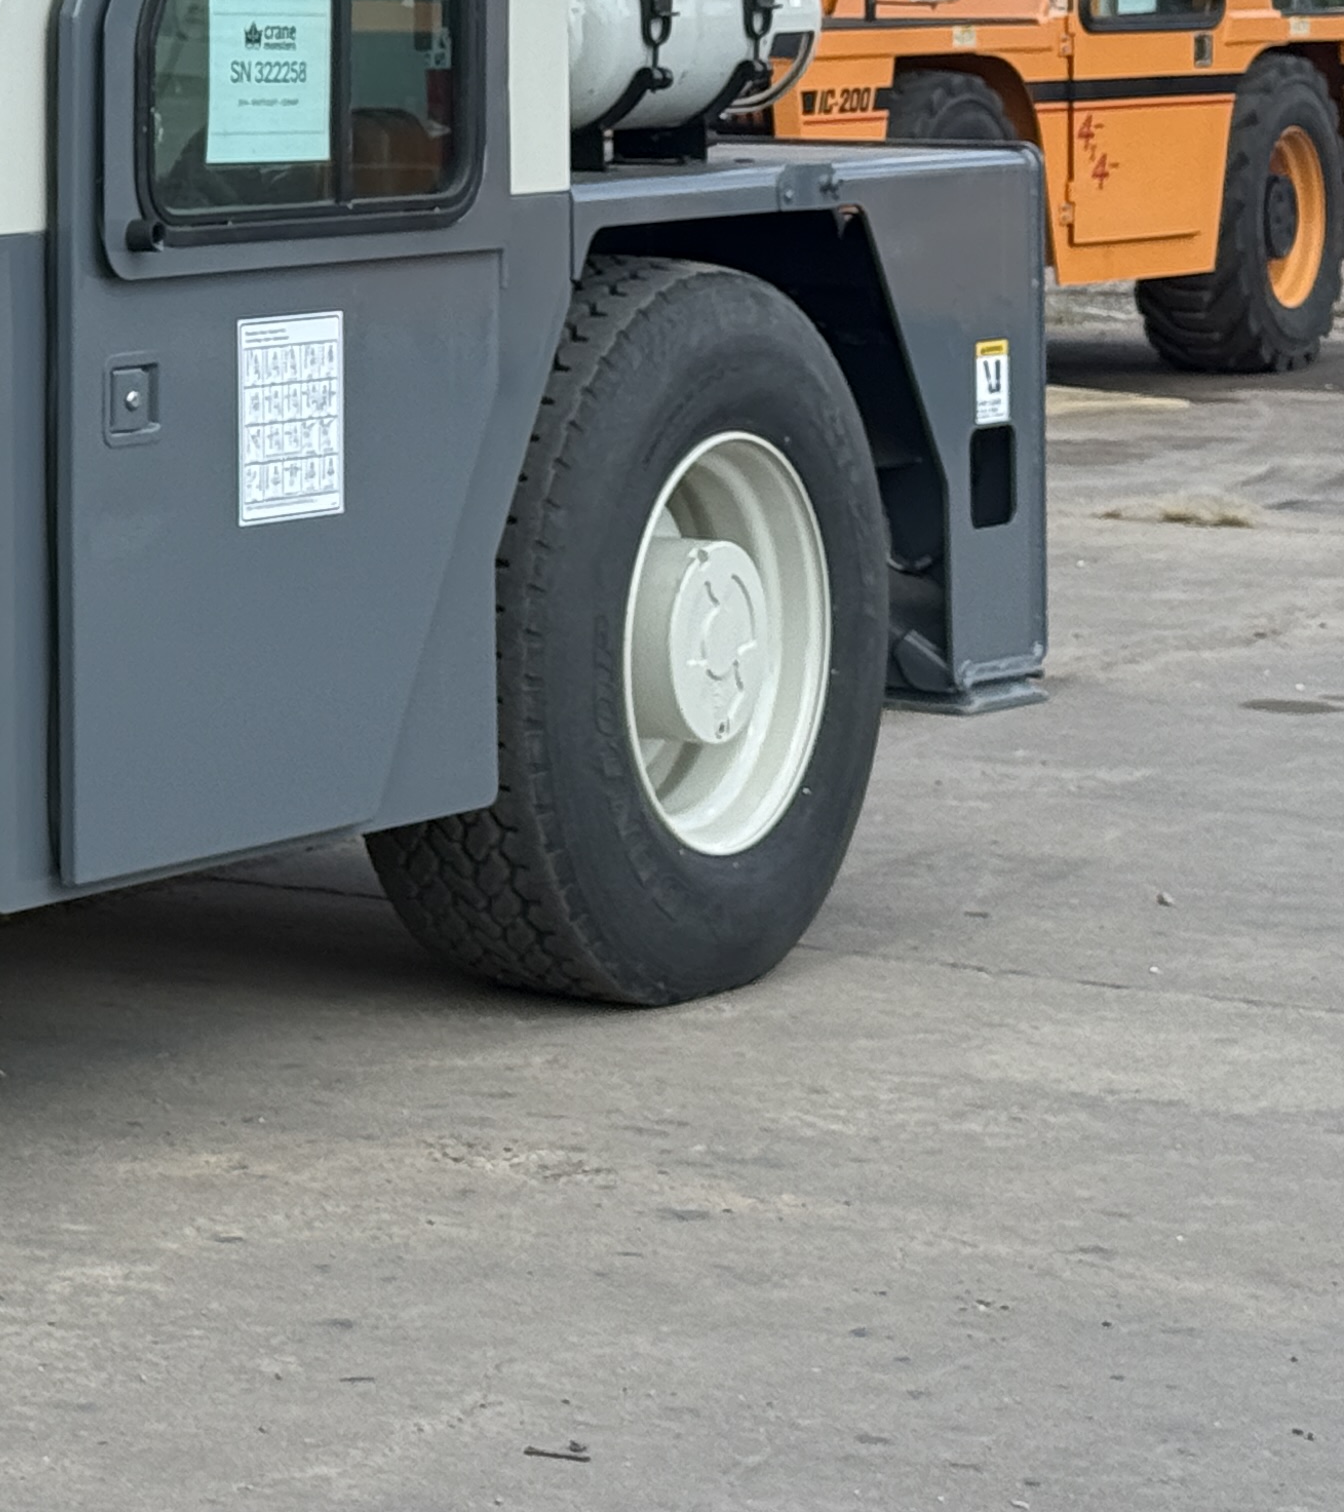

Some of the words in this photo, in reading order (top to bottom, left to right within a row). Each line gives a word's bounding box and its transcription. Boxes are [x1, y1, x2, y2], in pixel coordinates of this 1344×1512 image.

[229, 60, 252, 84] SN
[254, 60, 308, 84] 322258
[817, 86, 872, 116] IC-200
